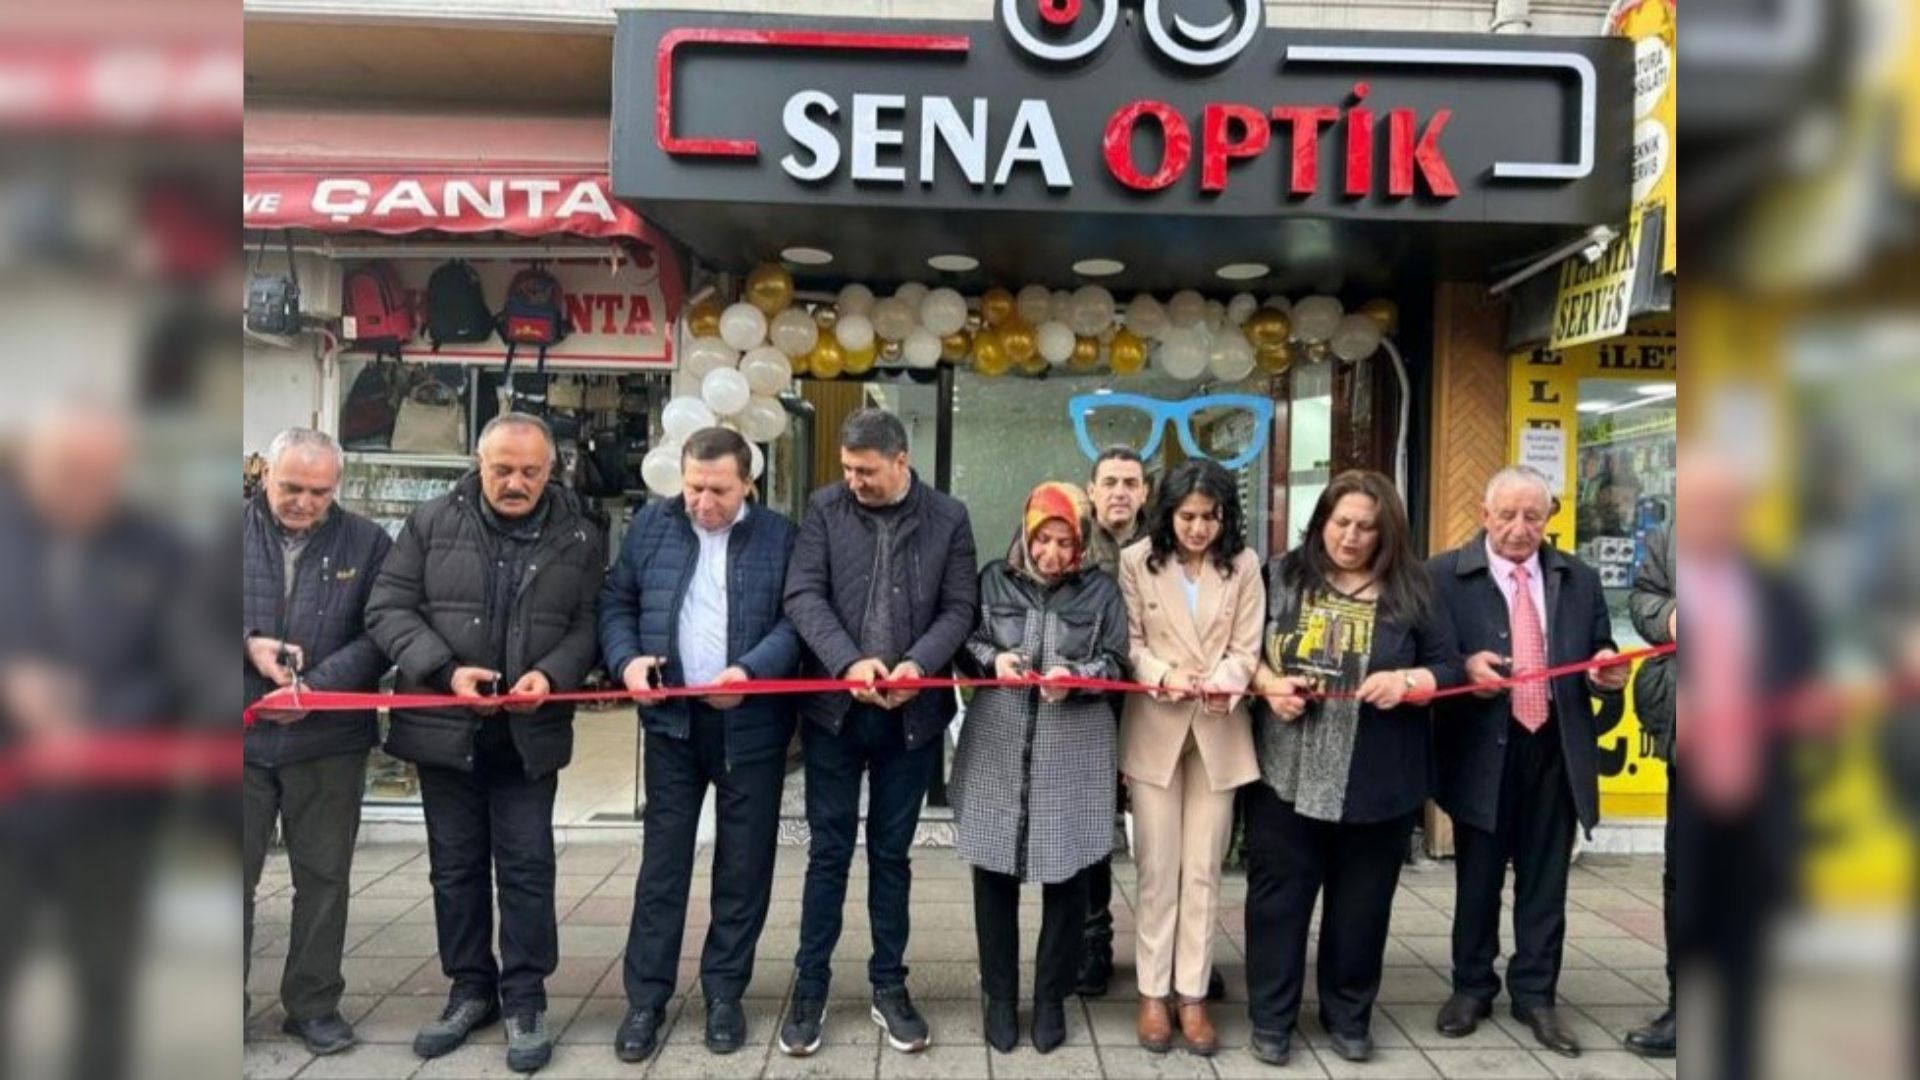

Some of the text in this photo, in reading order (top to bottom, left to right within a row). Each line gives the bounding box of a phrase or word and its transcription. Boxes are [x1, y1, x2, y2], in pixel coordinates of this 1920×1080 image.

[780, 82, 1460, 198] SENA OPTİK
[312, 179, 617, 223] ÇANTA
[565, 293, 656, 335] NTA
